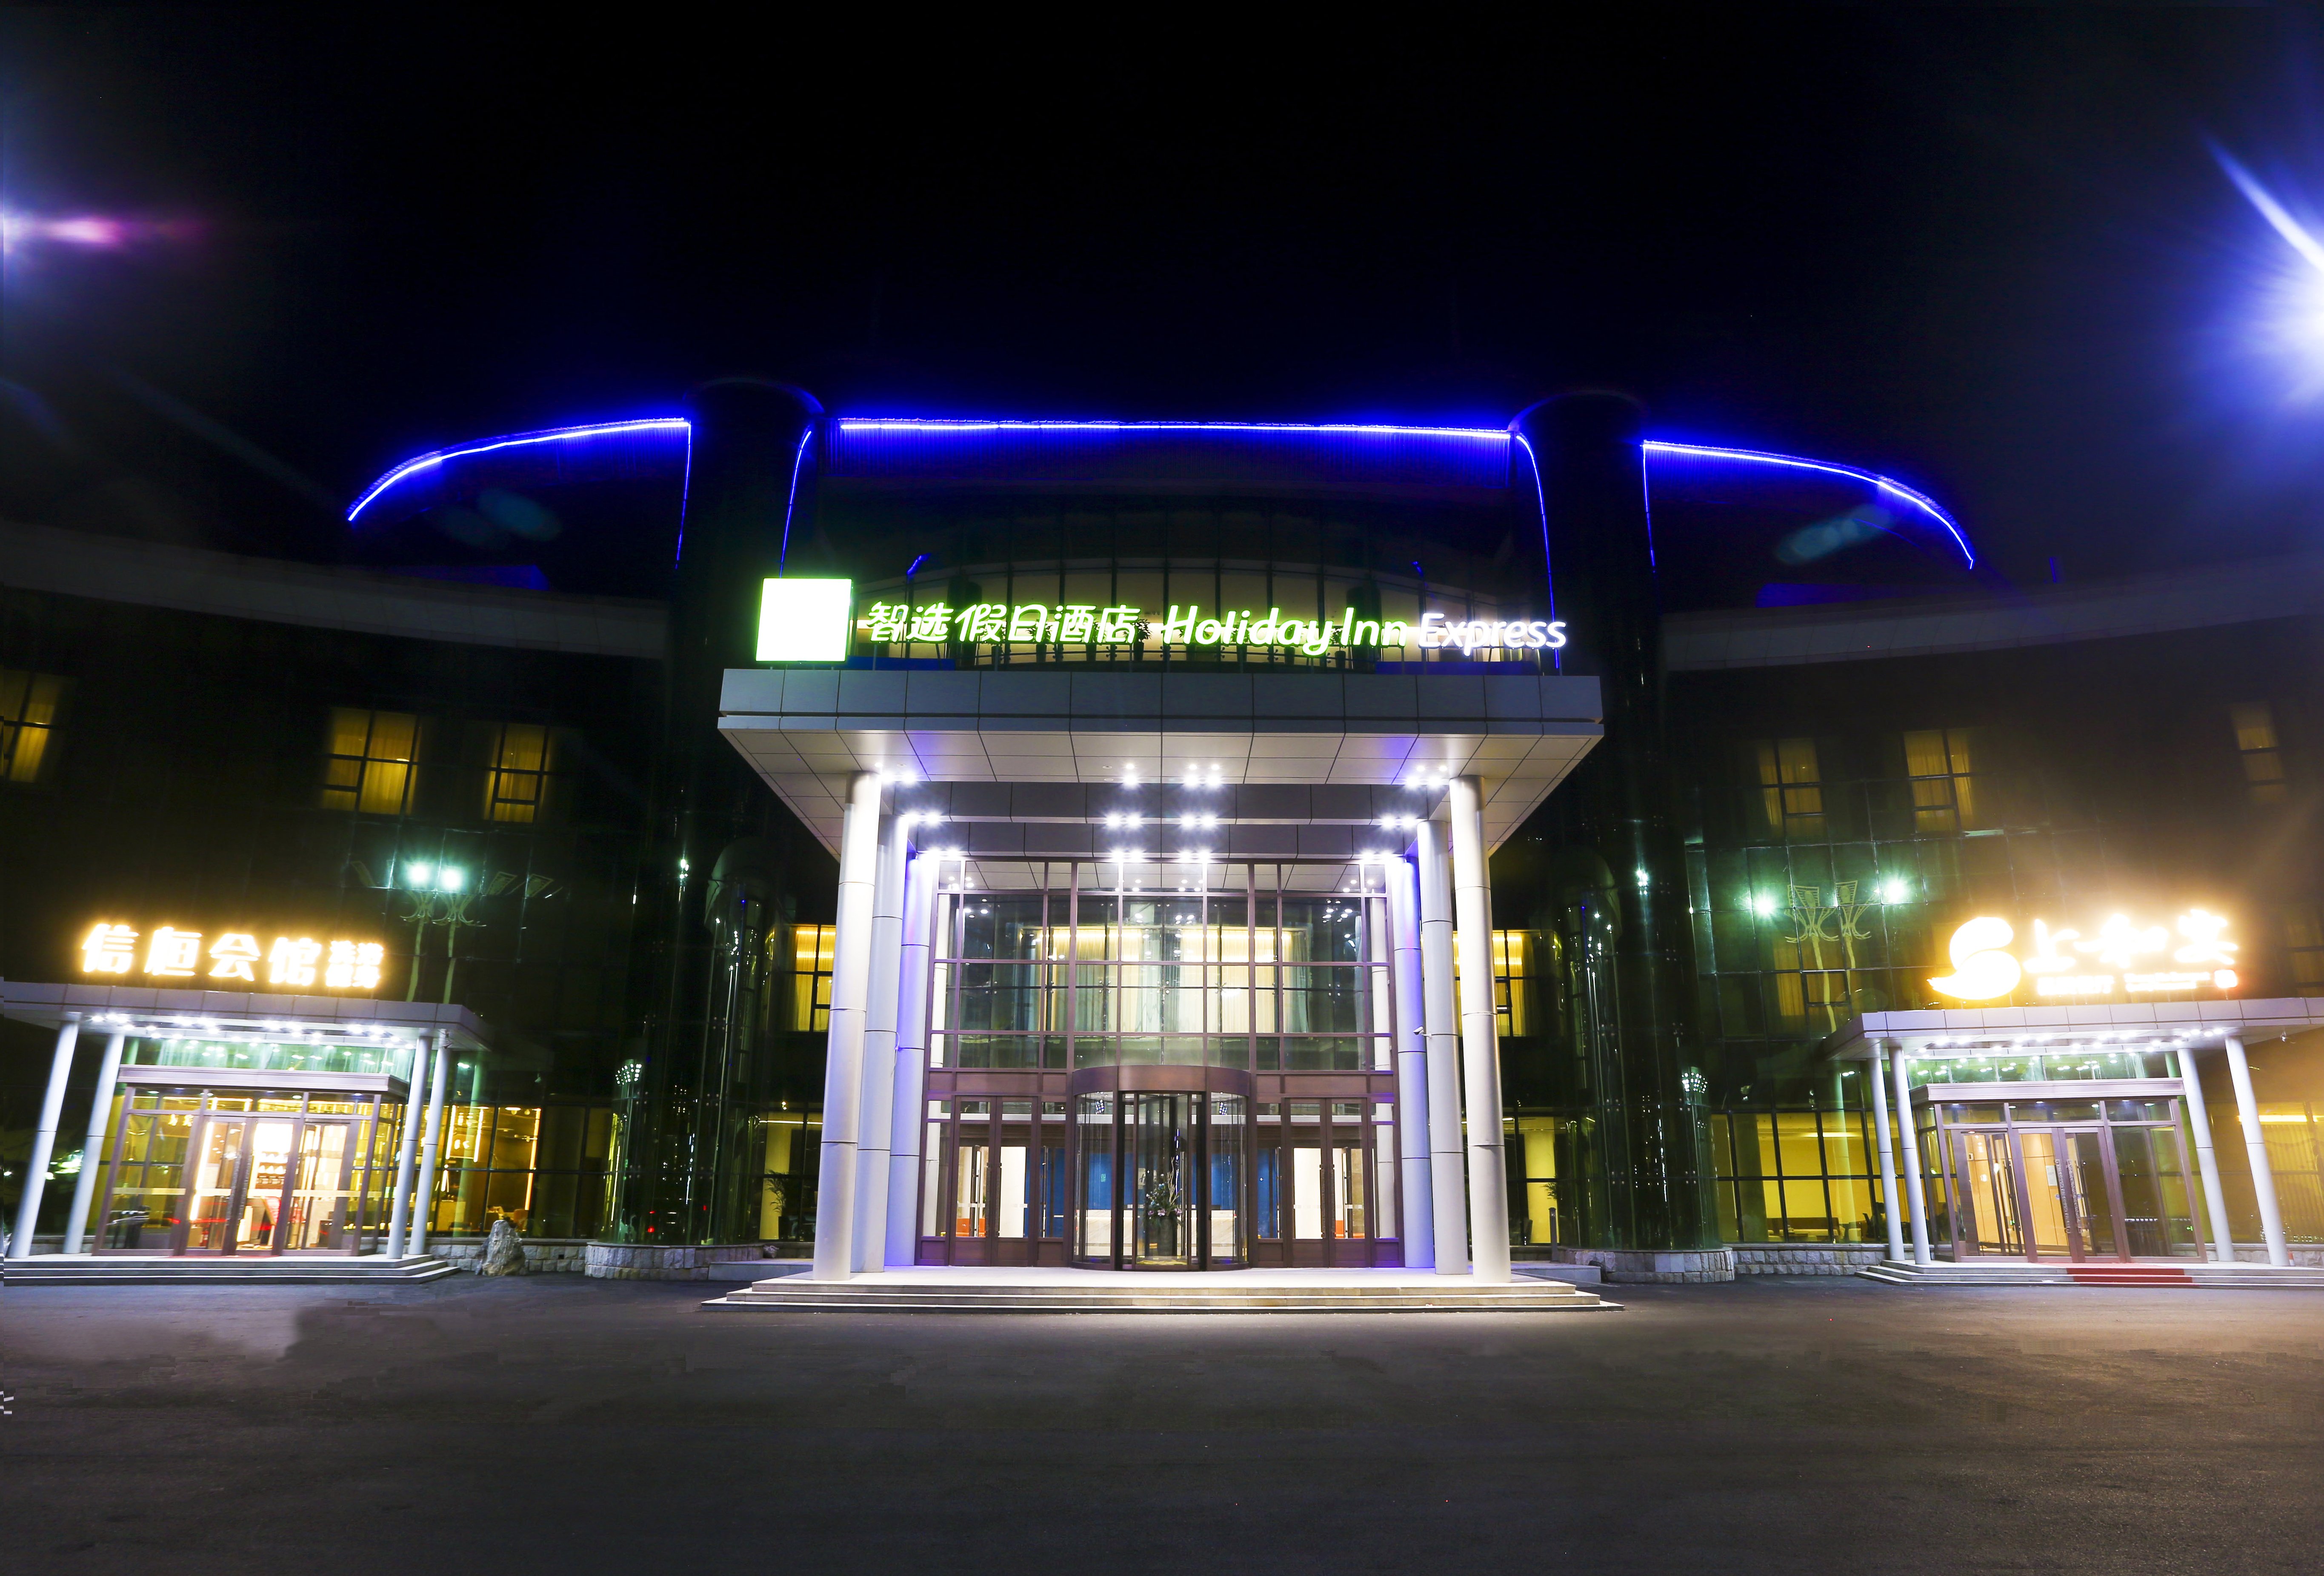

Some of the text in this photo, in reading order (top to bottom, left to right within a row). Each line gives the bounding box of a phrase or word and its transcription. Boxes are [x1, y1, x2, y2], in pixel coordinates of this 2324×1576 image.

[866, 600, 1141, 643] 智选假日酒店
[1163, 605, 1566, 656] Holiday Inn Express
